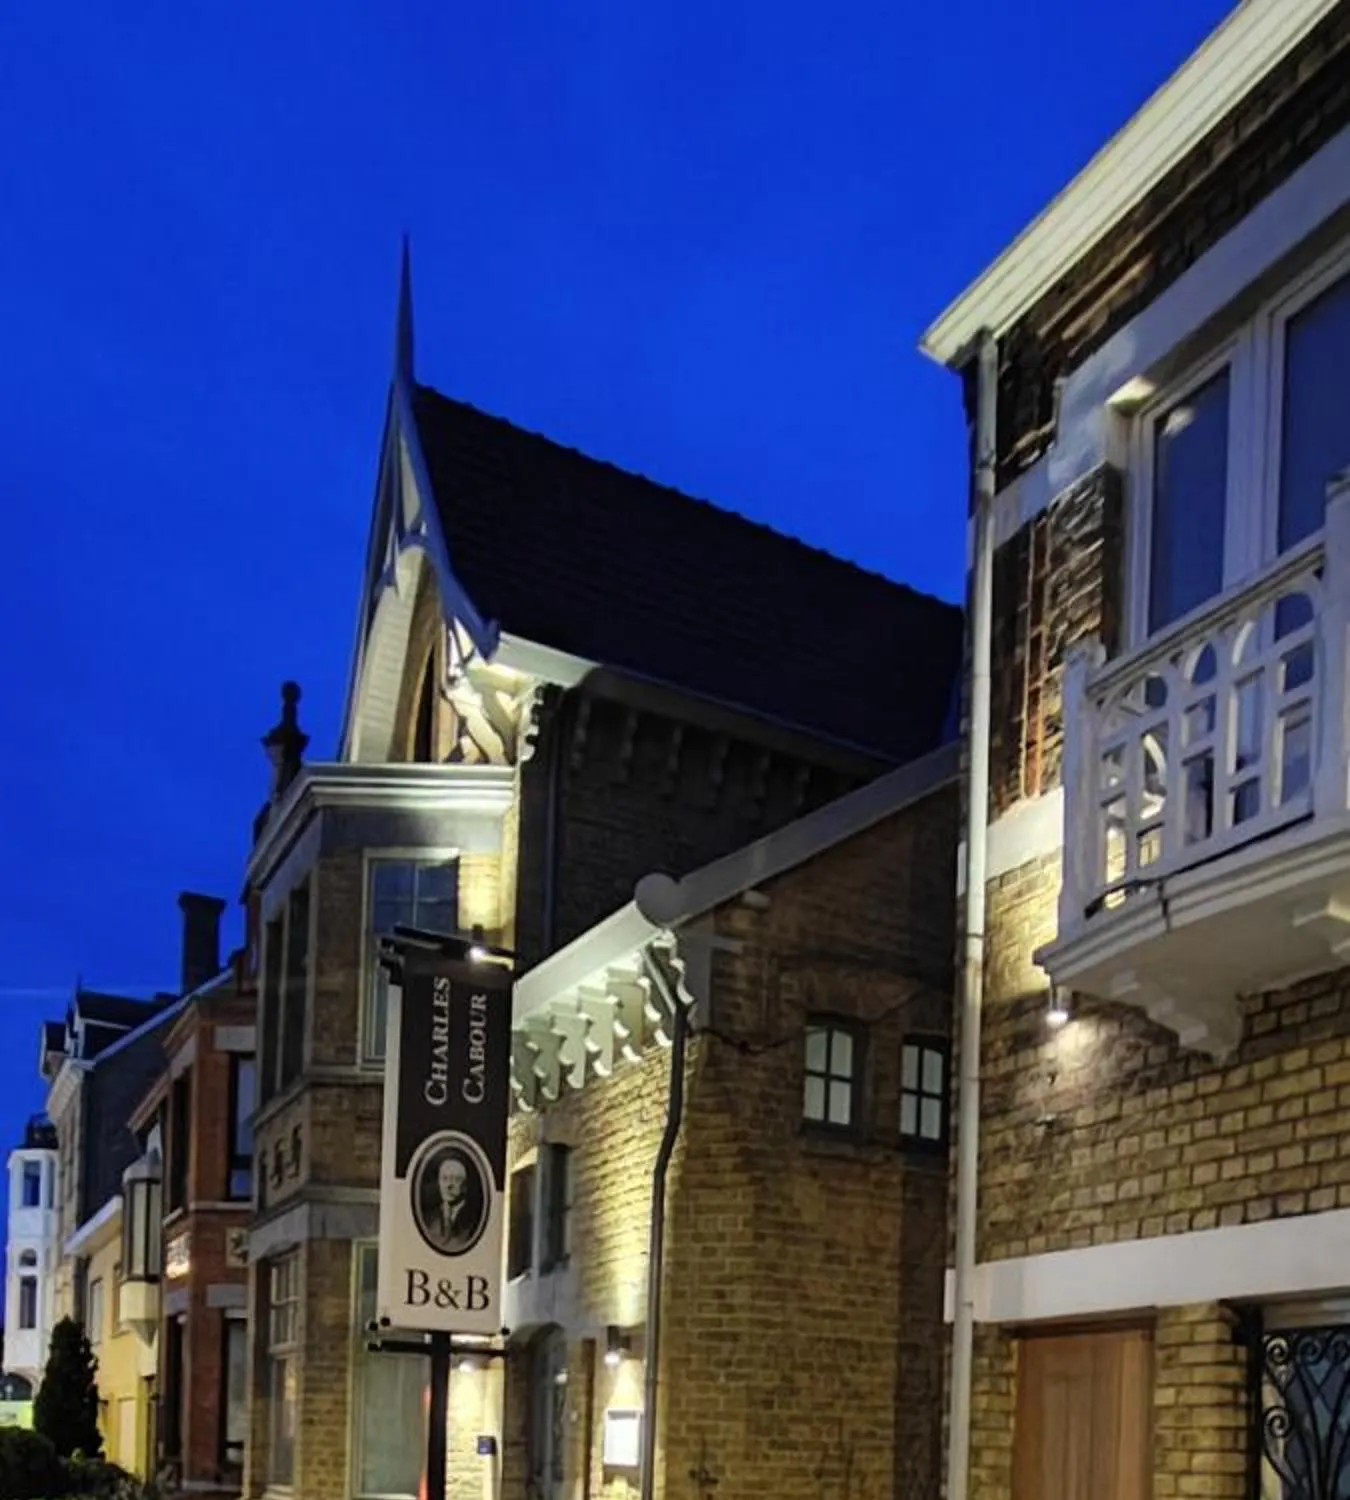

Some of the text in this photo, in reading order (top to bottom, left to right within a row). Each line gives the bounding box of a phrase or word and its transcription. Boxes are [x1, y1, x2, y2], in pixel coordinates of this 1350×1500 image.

[424, 976, 450, 1105] CHARLES
[462, 993, 487, 1103] CABOUR
[404, 1268, 490, 1311] B&B
